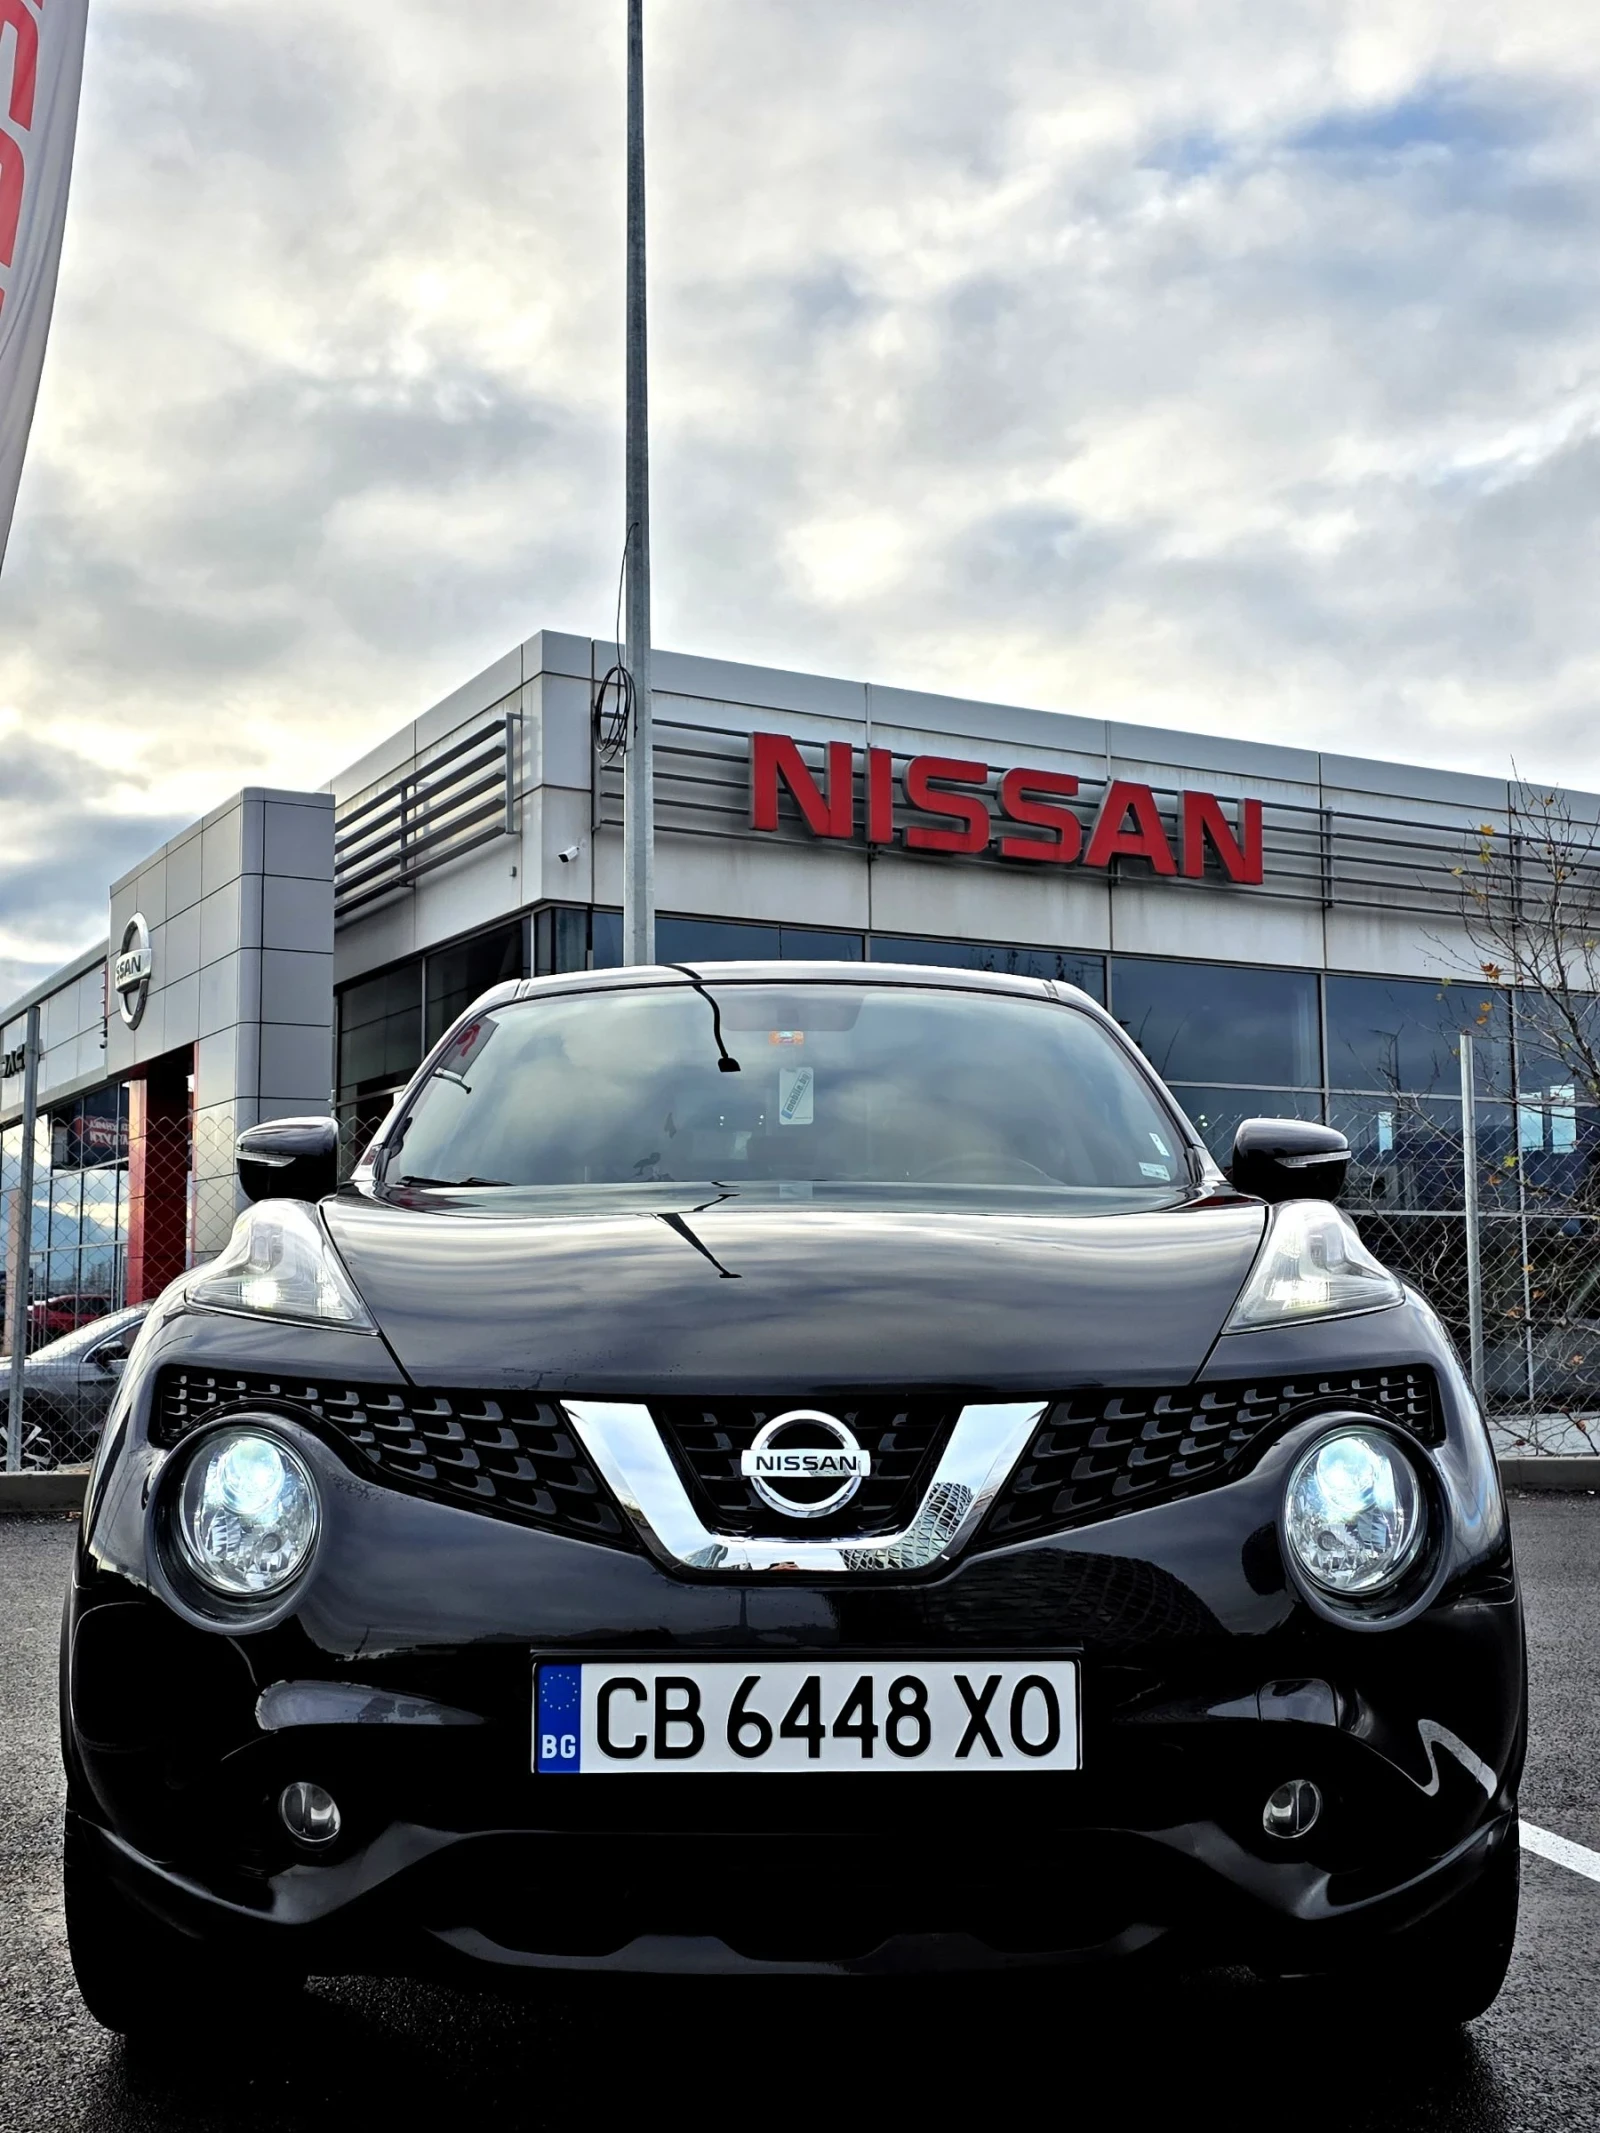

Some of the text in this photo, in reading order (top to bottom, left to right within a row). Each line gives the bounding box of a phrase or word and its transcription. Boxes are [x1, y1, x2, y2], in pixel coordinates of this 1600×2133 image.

[749, 731, 1263, 885] NISSAN
[756, 1456, 857, 1471] NISSAN
[597, 1674, 1061, 1759] CB 6448 XO
[542, 1734, 576, 1759] BG
